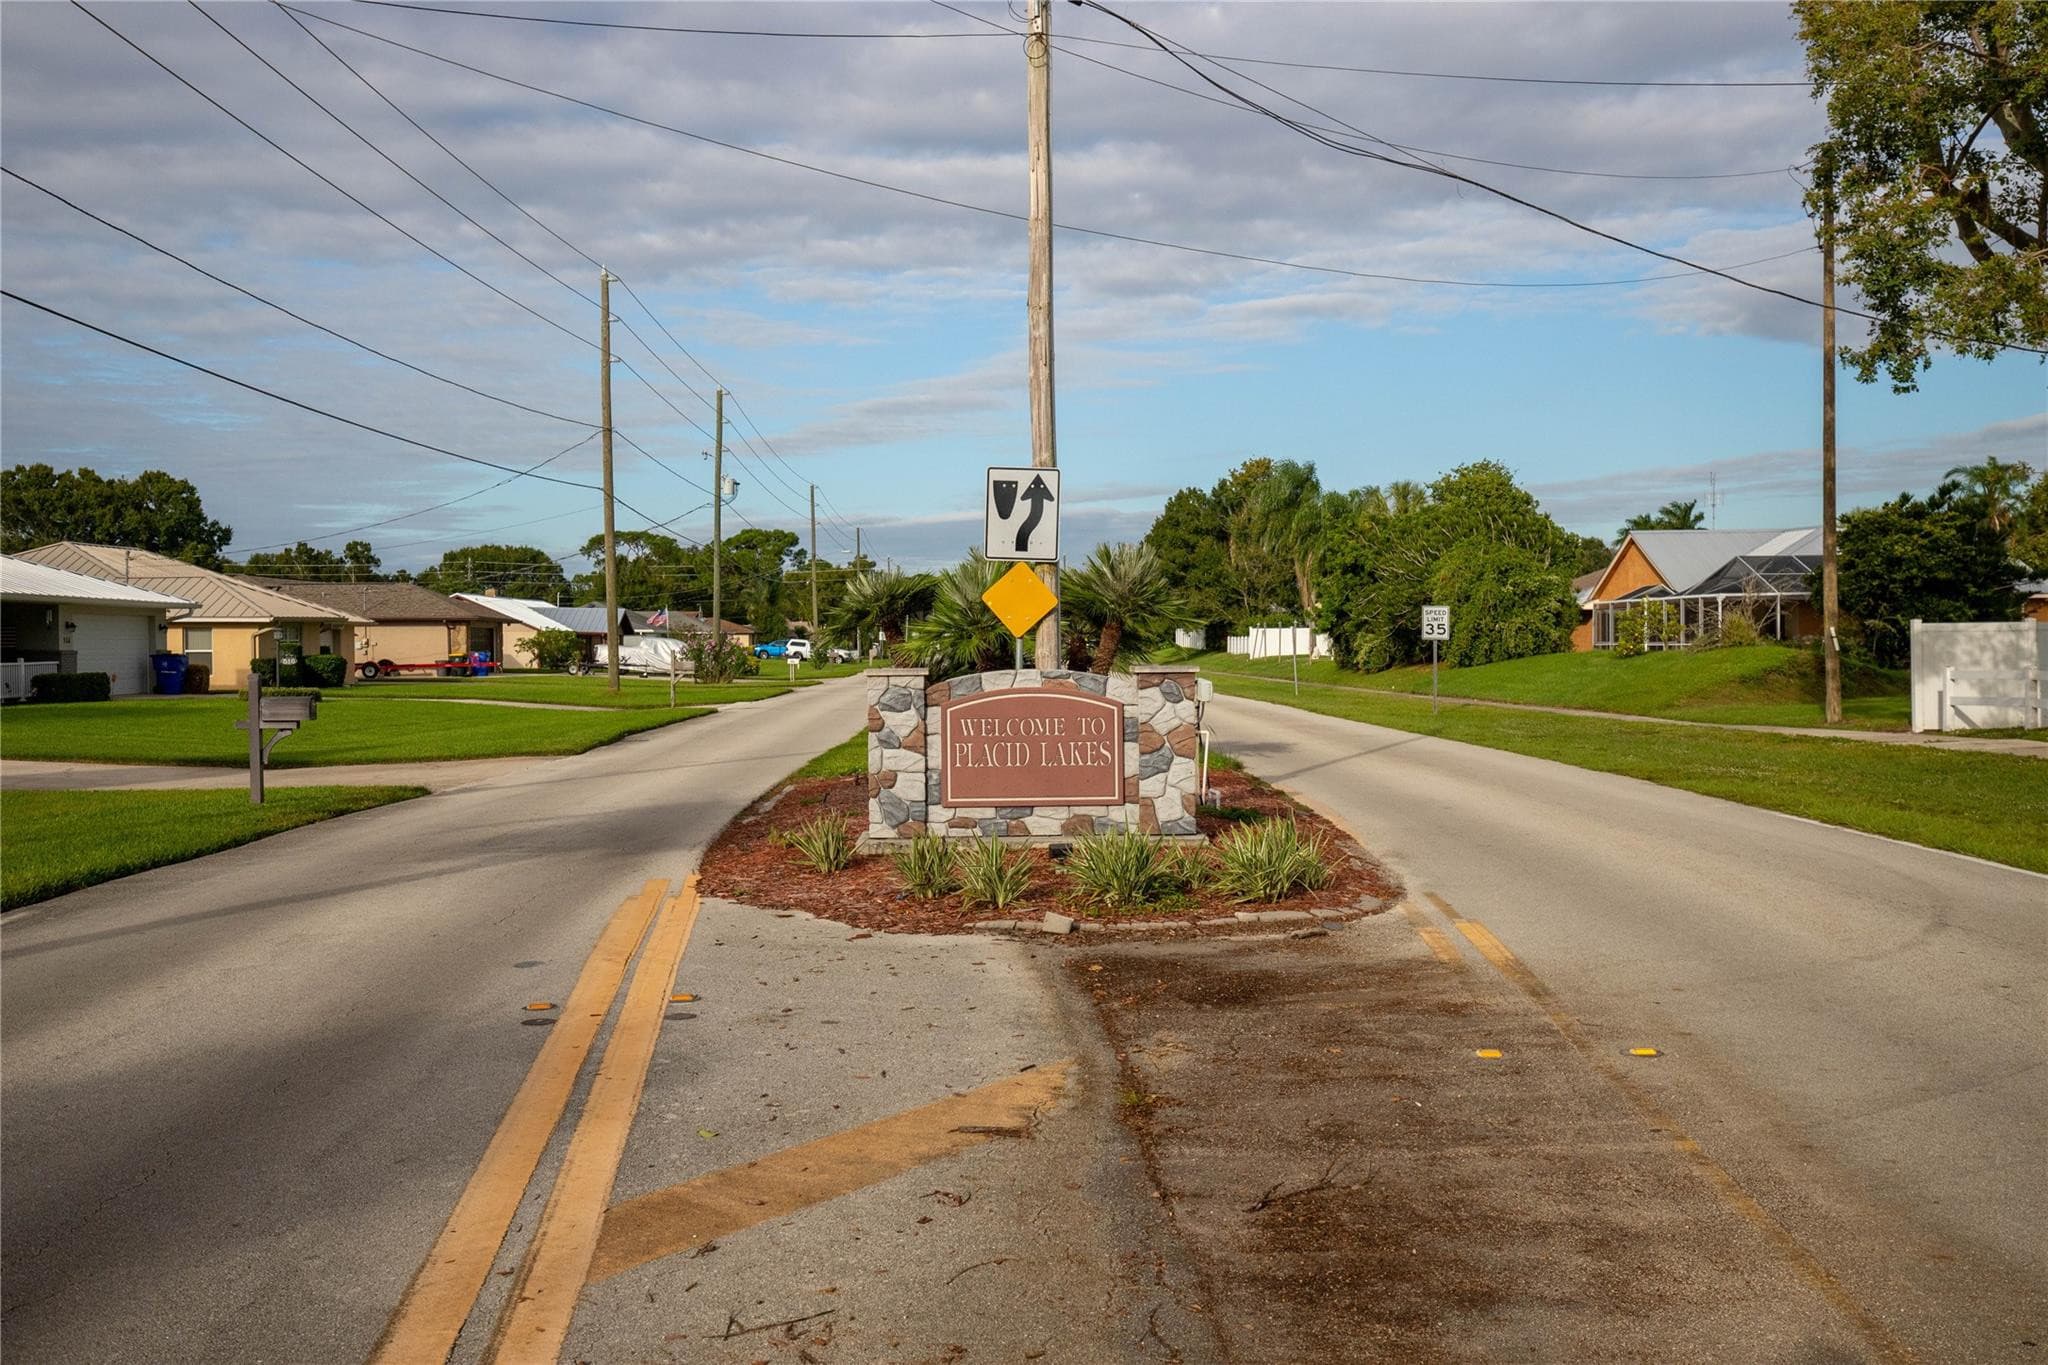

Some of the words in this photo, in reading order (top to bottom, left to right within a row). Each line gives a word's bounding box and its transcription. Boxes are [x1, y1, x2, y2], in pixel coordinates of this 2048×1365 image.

[1425, 623, 1446, 635] 35
[961, 718, 1065, 737] WELCOME
[1077, 717, 1106, 736] TO
[954, 742, 1030, 768] PLACID
[1040, 740, 1112, 767] LAKES
